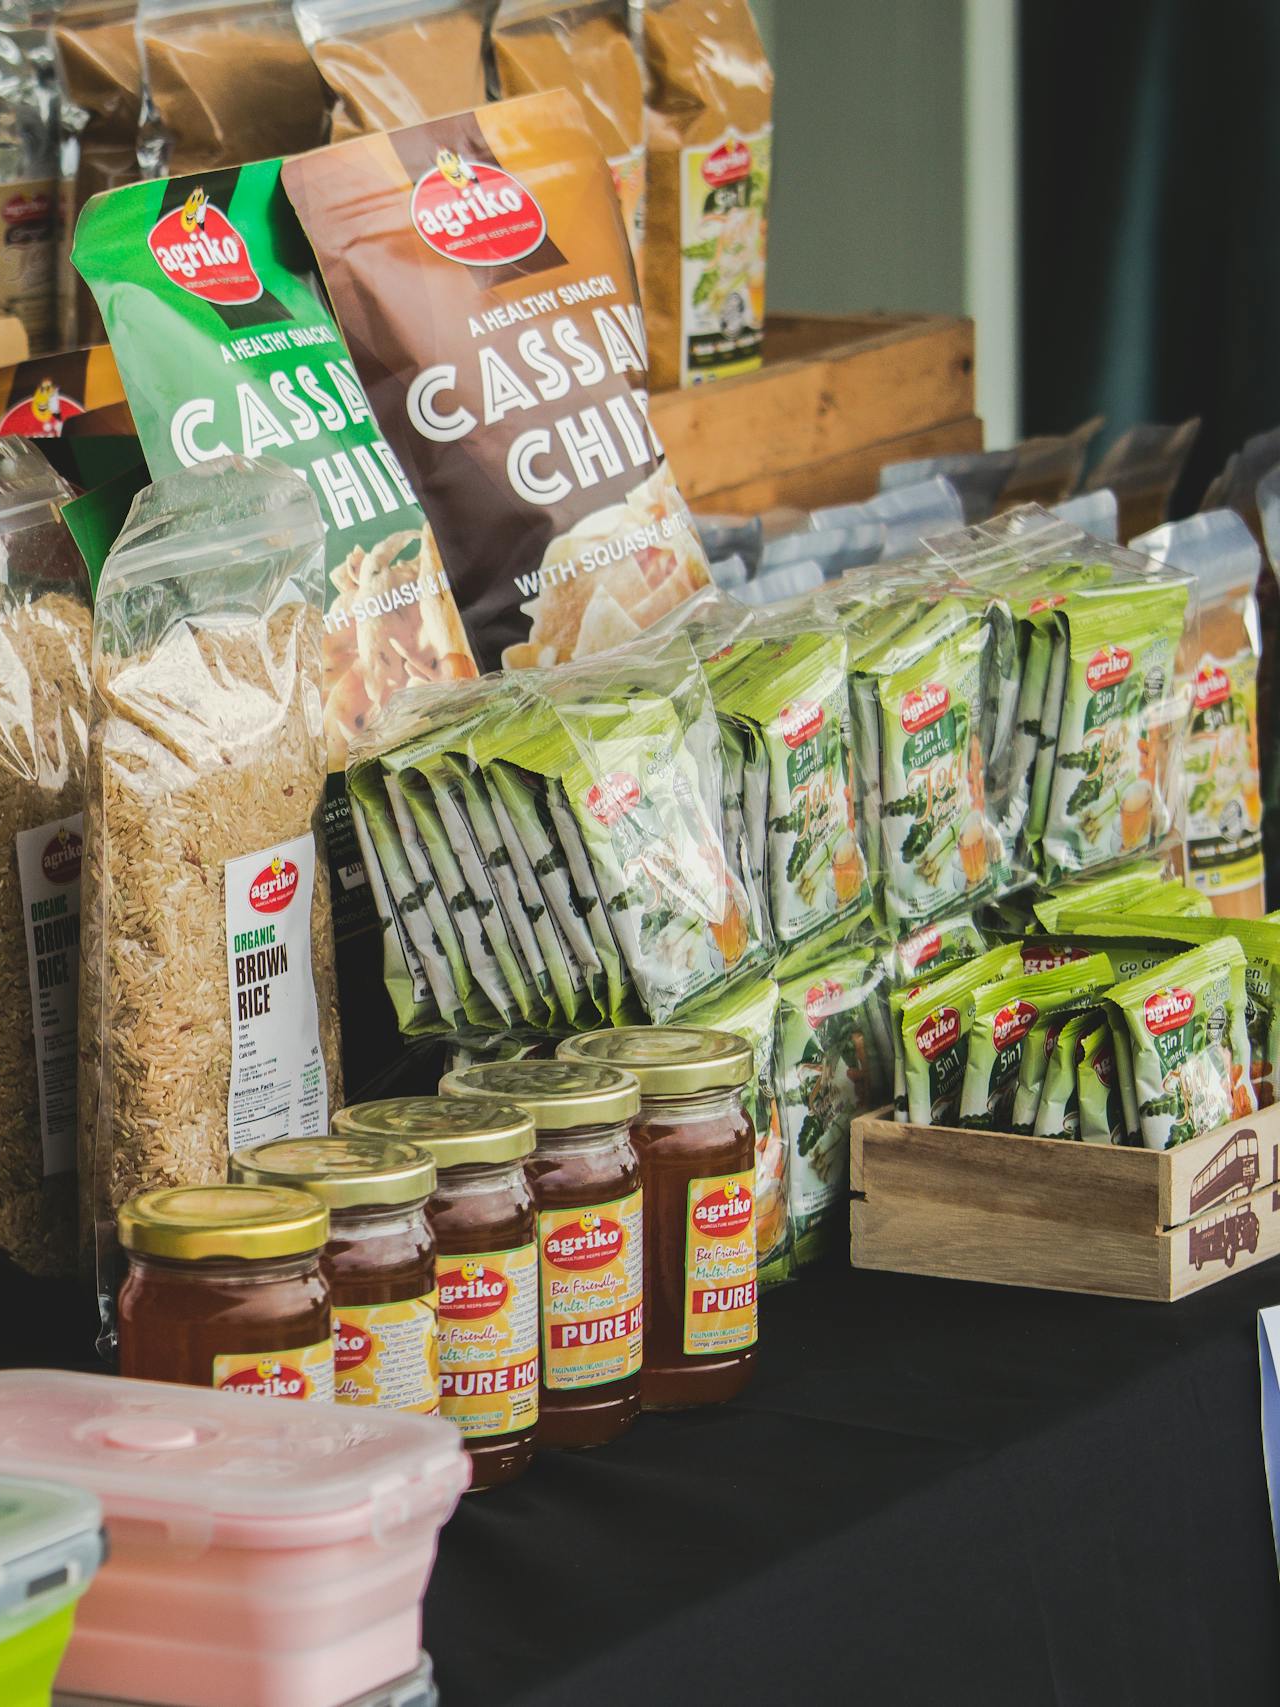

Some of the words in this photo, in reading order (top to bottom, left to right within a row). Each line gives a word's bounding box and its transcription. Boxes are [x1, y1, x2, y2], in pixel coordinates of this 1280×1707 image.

[418, 184, 523, 237] agriko
[157, 232, 240, 278] agriko
[467, 317, 486, 338] A
[481, 291, 560, 332] HEALTHY
[556, 274, 618, 306] SNACK!
[220, 344, 233, 364] A
[231, 331, 293, 361] HEALTHY
[287, 325, 337, 350] SNACK!
[170, 360, 377, 468] CASSA
[513, 559, 578, 598] WITH
[578, 528, 660, 574] SQUASH
[660, 519, 673, 539] &
[352, 582, 423, 624] SQUASH
[424, 573, 441, 596] &
[1086, 655, 1129, 681] agriko
[901, 688, 946, 723] agriko
[909, 738, 951, 769] Turmeric
[42, 844, 83, 872] agriko
[250, 869, 297, 900] agriko
[31, 894, 68, 922] ORGANIC
[234, 924, 276, 954] ORGANIC
[37, 954, 70, 989] RICE
[235, 943, 289, 988] BROWN
[1120, 961, 1137, 974] Go
[1141, 958, 1166, 970] Gre
[1245, 981, 1269, 995] esh!
[237, 984, 271, 1022] RICE
[1146, 996, 1192, 1022] agriko
[917, 1015, 956, 1047] agriko
[238, 1049, 257, 1060] Calcium
[234, 1087, 260, 1098] Nutrition
[260, 1082, 274, 1091] Facts
[695, 1196, 751, 1222] agriko
[547, 1229, 619, 1256] agriko
[696, 1248, 712, 1262] Bee
[553, 1254, 586, 1263] AGRICULTURE
[440, 1279, 504, 1303] griko
[552, 1281, 569, 1295] Bee
[702, 1285, 753, 1314] PURE
[437, 1334, 447, 1343] ee
[562, 1314, 626, 1347] PURE
[222, 1377, 302, 1398] agriko
[440, 1369, 508, 1396] PURE
[514, 1359, 539, 1390] HO
